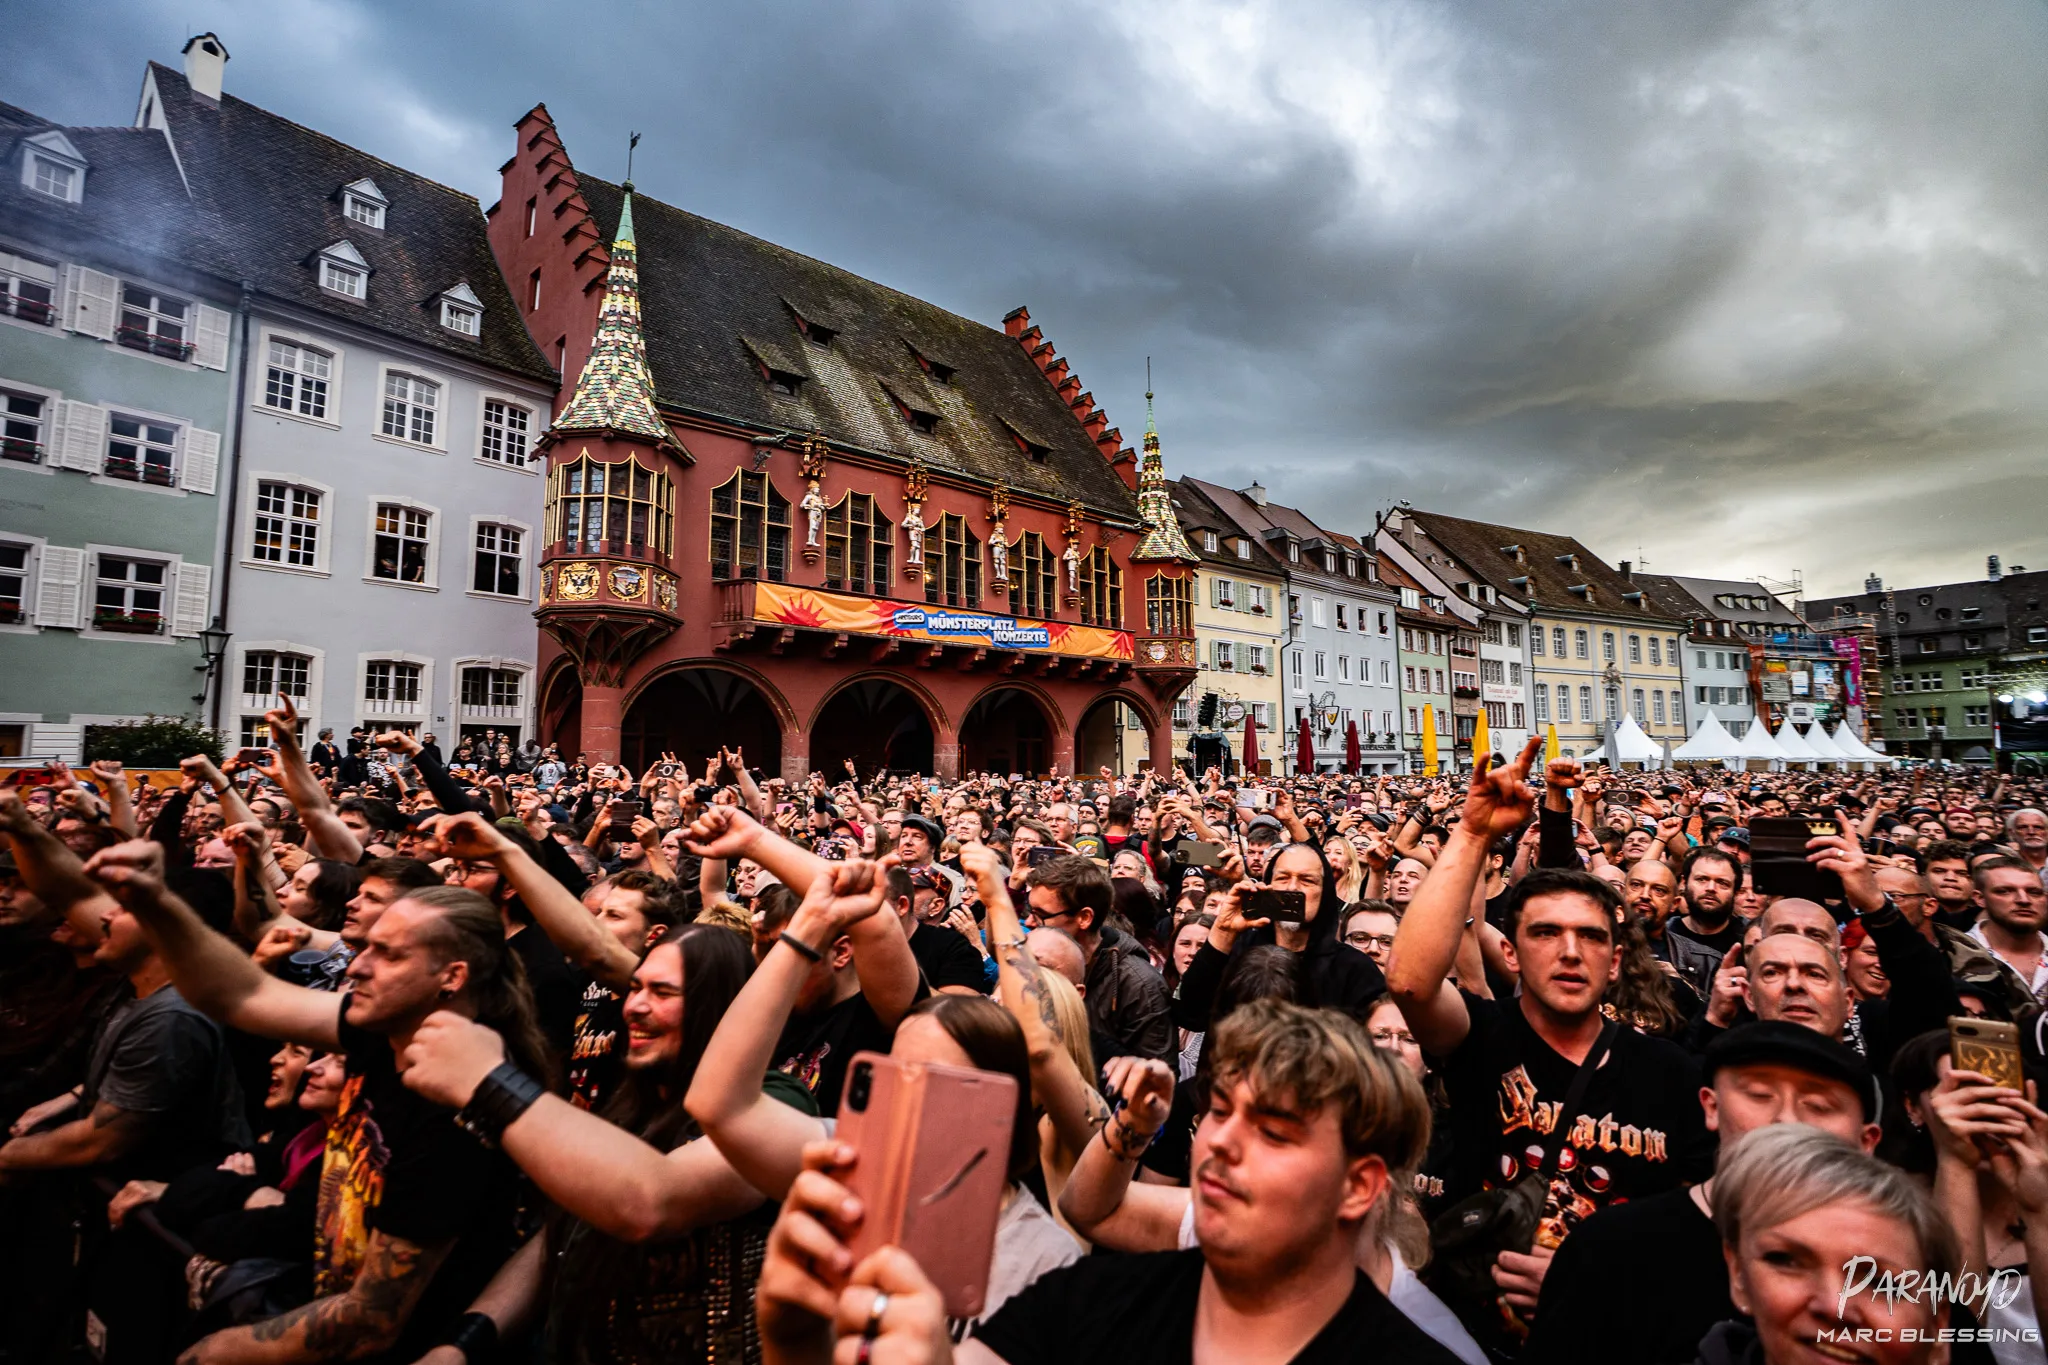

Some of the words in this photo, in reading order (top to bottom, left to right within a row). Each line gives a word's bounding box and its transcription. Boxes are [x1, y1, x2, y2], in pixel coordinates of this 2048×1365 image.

[927, 614, 1015, 631] MÜNSTERPLATZ
[993, 630, 1047, 642] KONZERTE
[1497, 1063, 1668, 1164] Saaton
